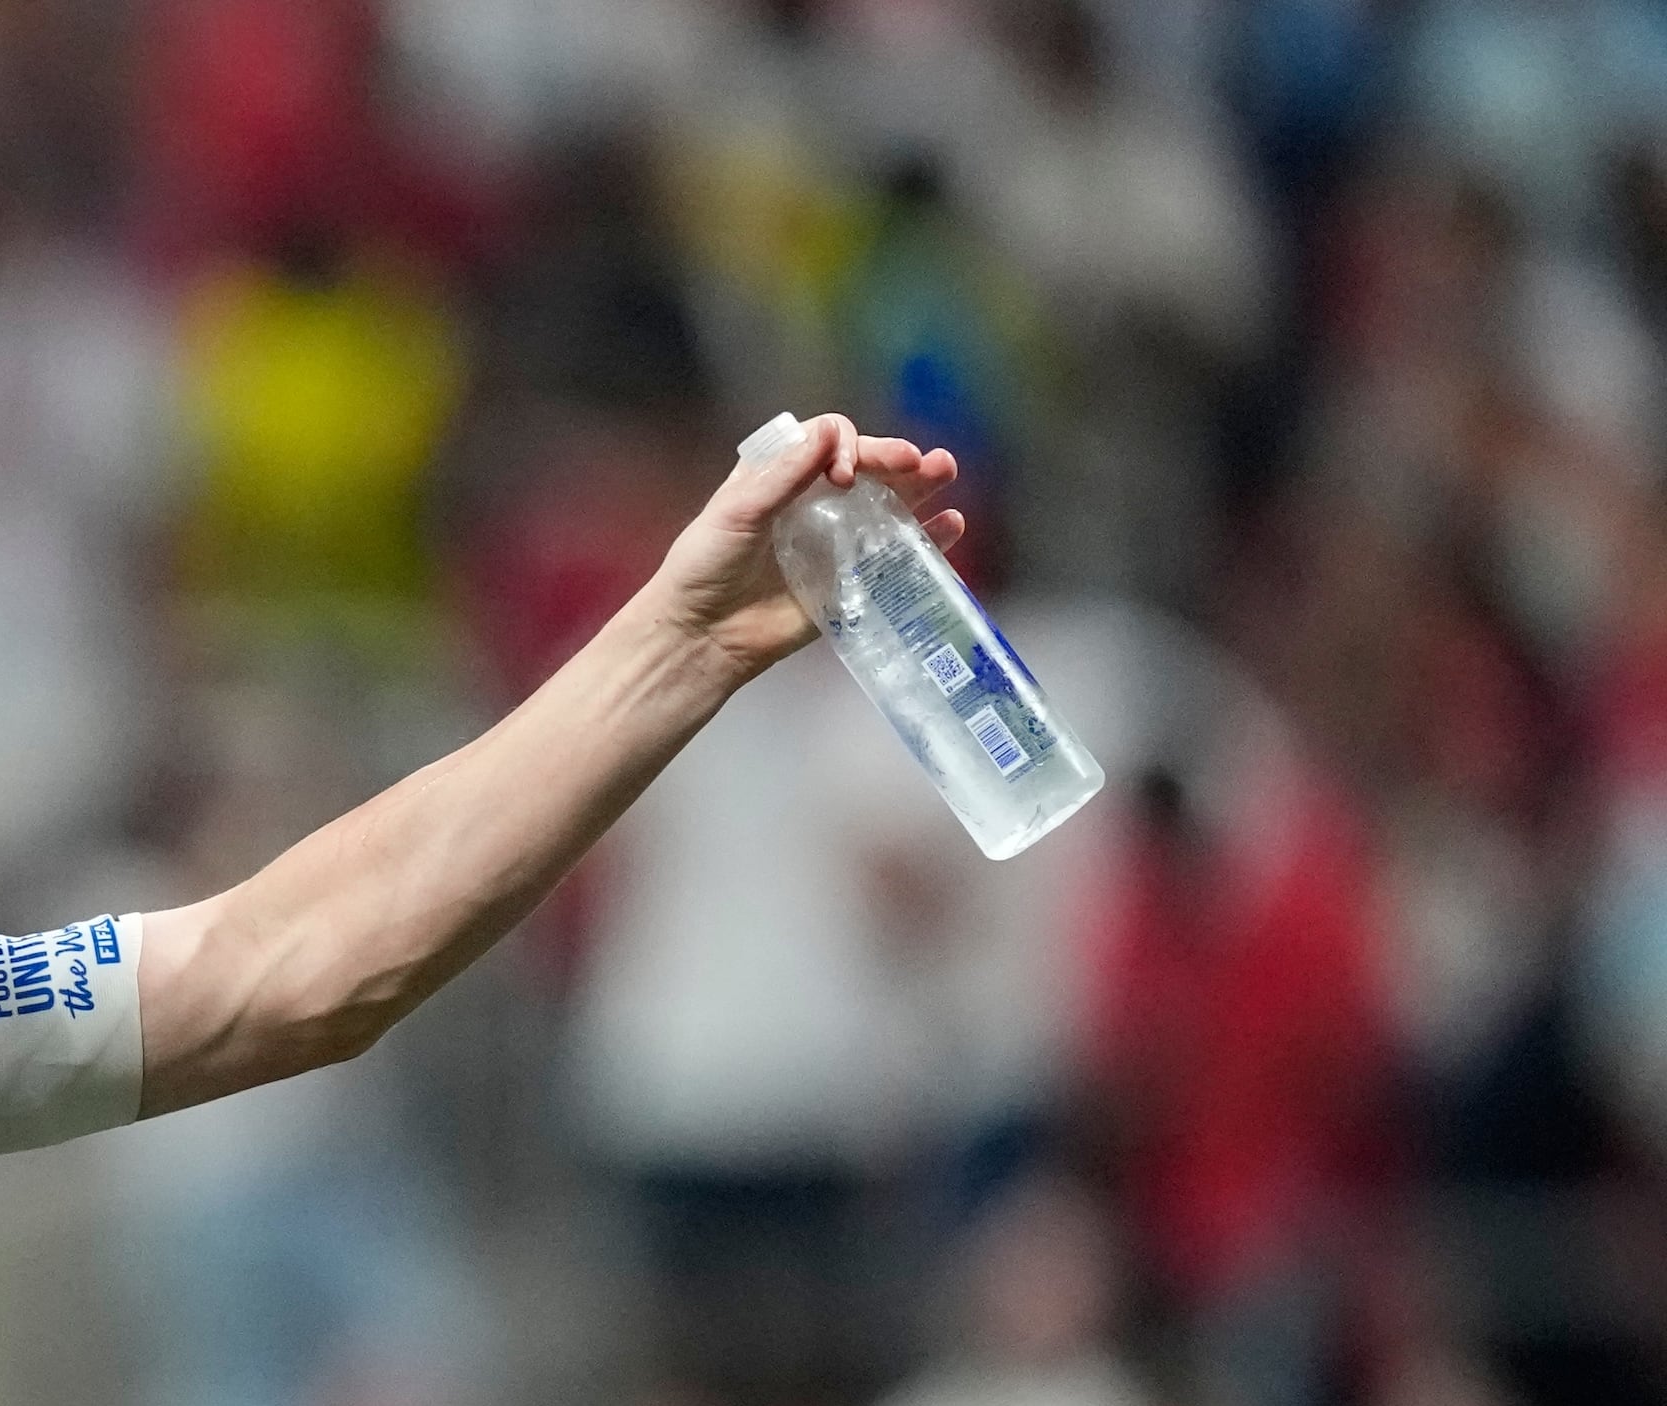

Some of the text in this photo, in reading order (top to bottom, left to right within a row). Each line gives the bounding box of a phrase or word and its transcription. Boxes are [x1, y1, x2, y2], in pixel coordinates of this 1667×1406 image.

[94, 921, 117, 959] FIFA
[6, 932, 56, 1015] UNIT
[59, 959, 95, 1019] the
